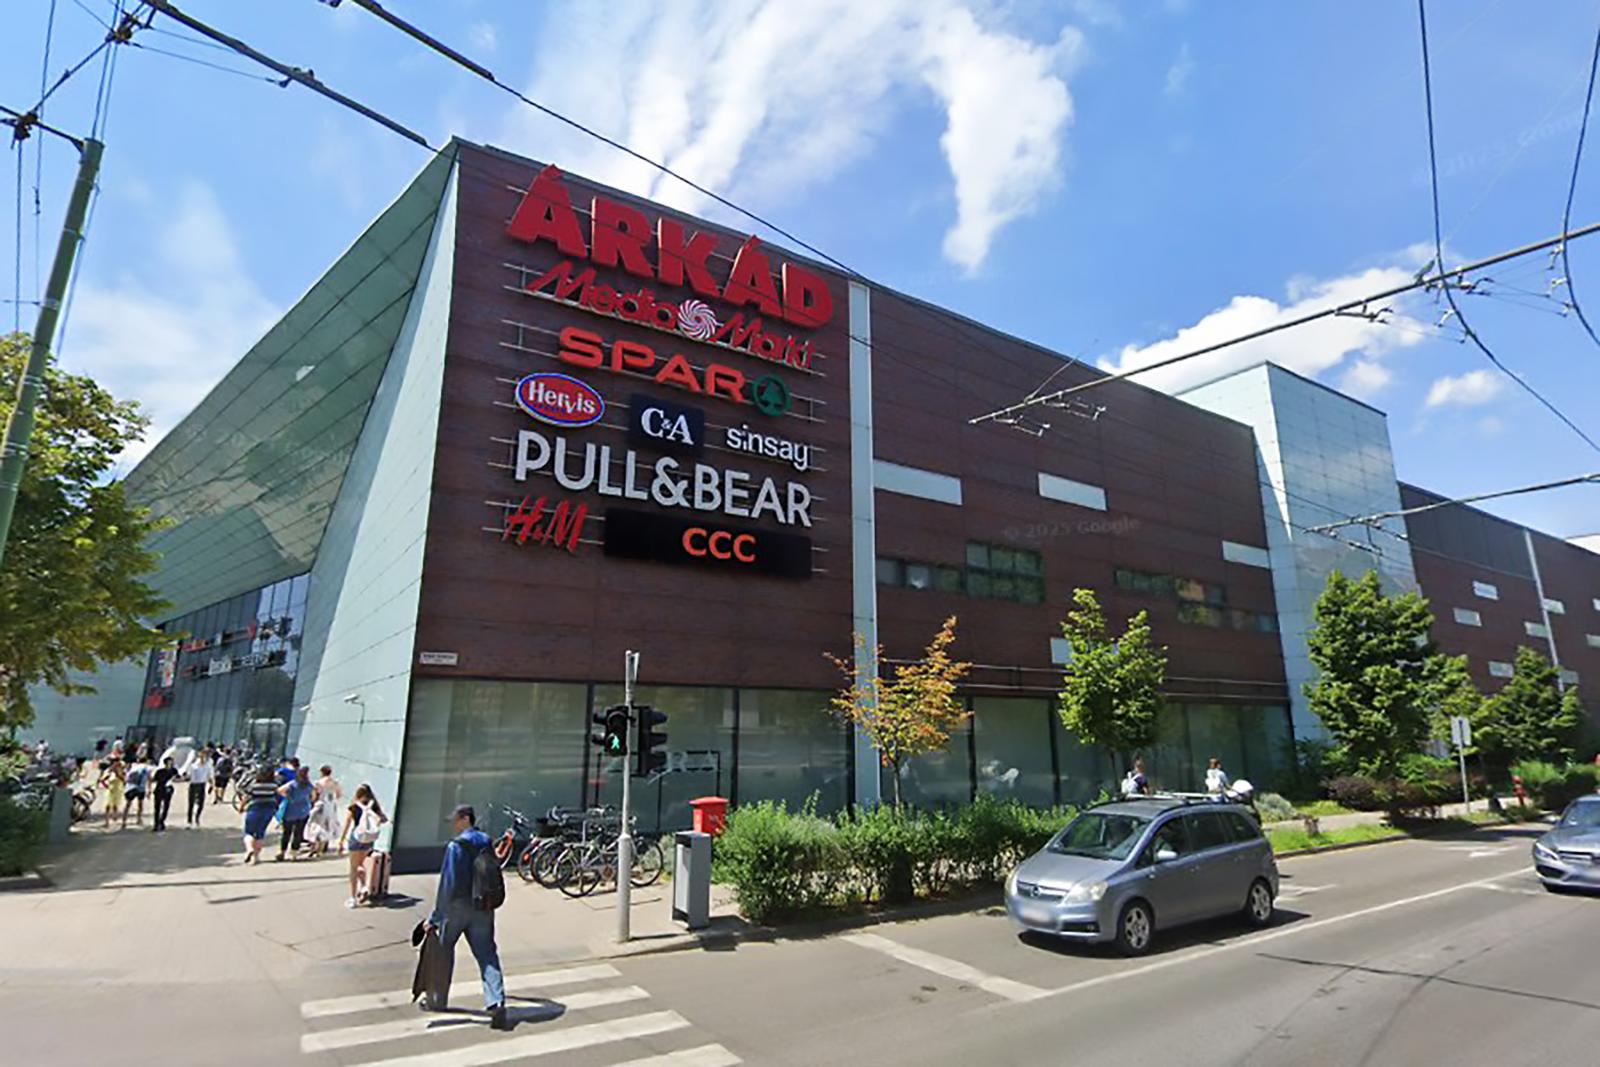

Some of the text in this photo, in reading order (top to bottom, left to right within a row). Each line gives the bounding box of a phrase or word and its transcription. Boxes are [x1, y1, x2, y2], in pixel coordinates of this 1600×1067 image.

[559, 326, 746, 402] SPAR
[527, 380, 596, 414] Hervis
[640, 407, 694, 446] C&A
[726, 424, 809, 471] sinsay
[514, 429, 812, 528] PULL&BEAR
[681, 527, 757, 562] CCC
